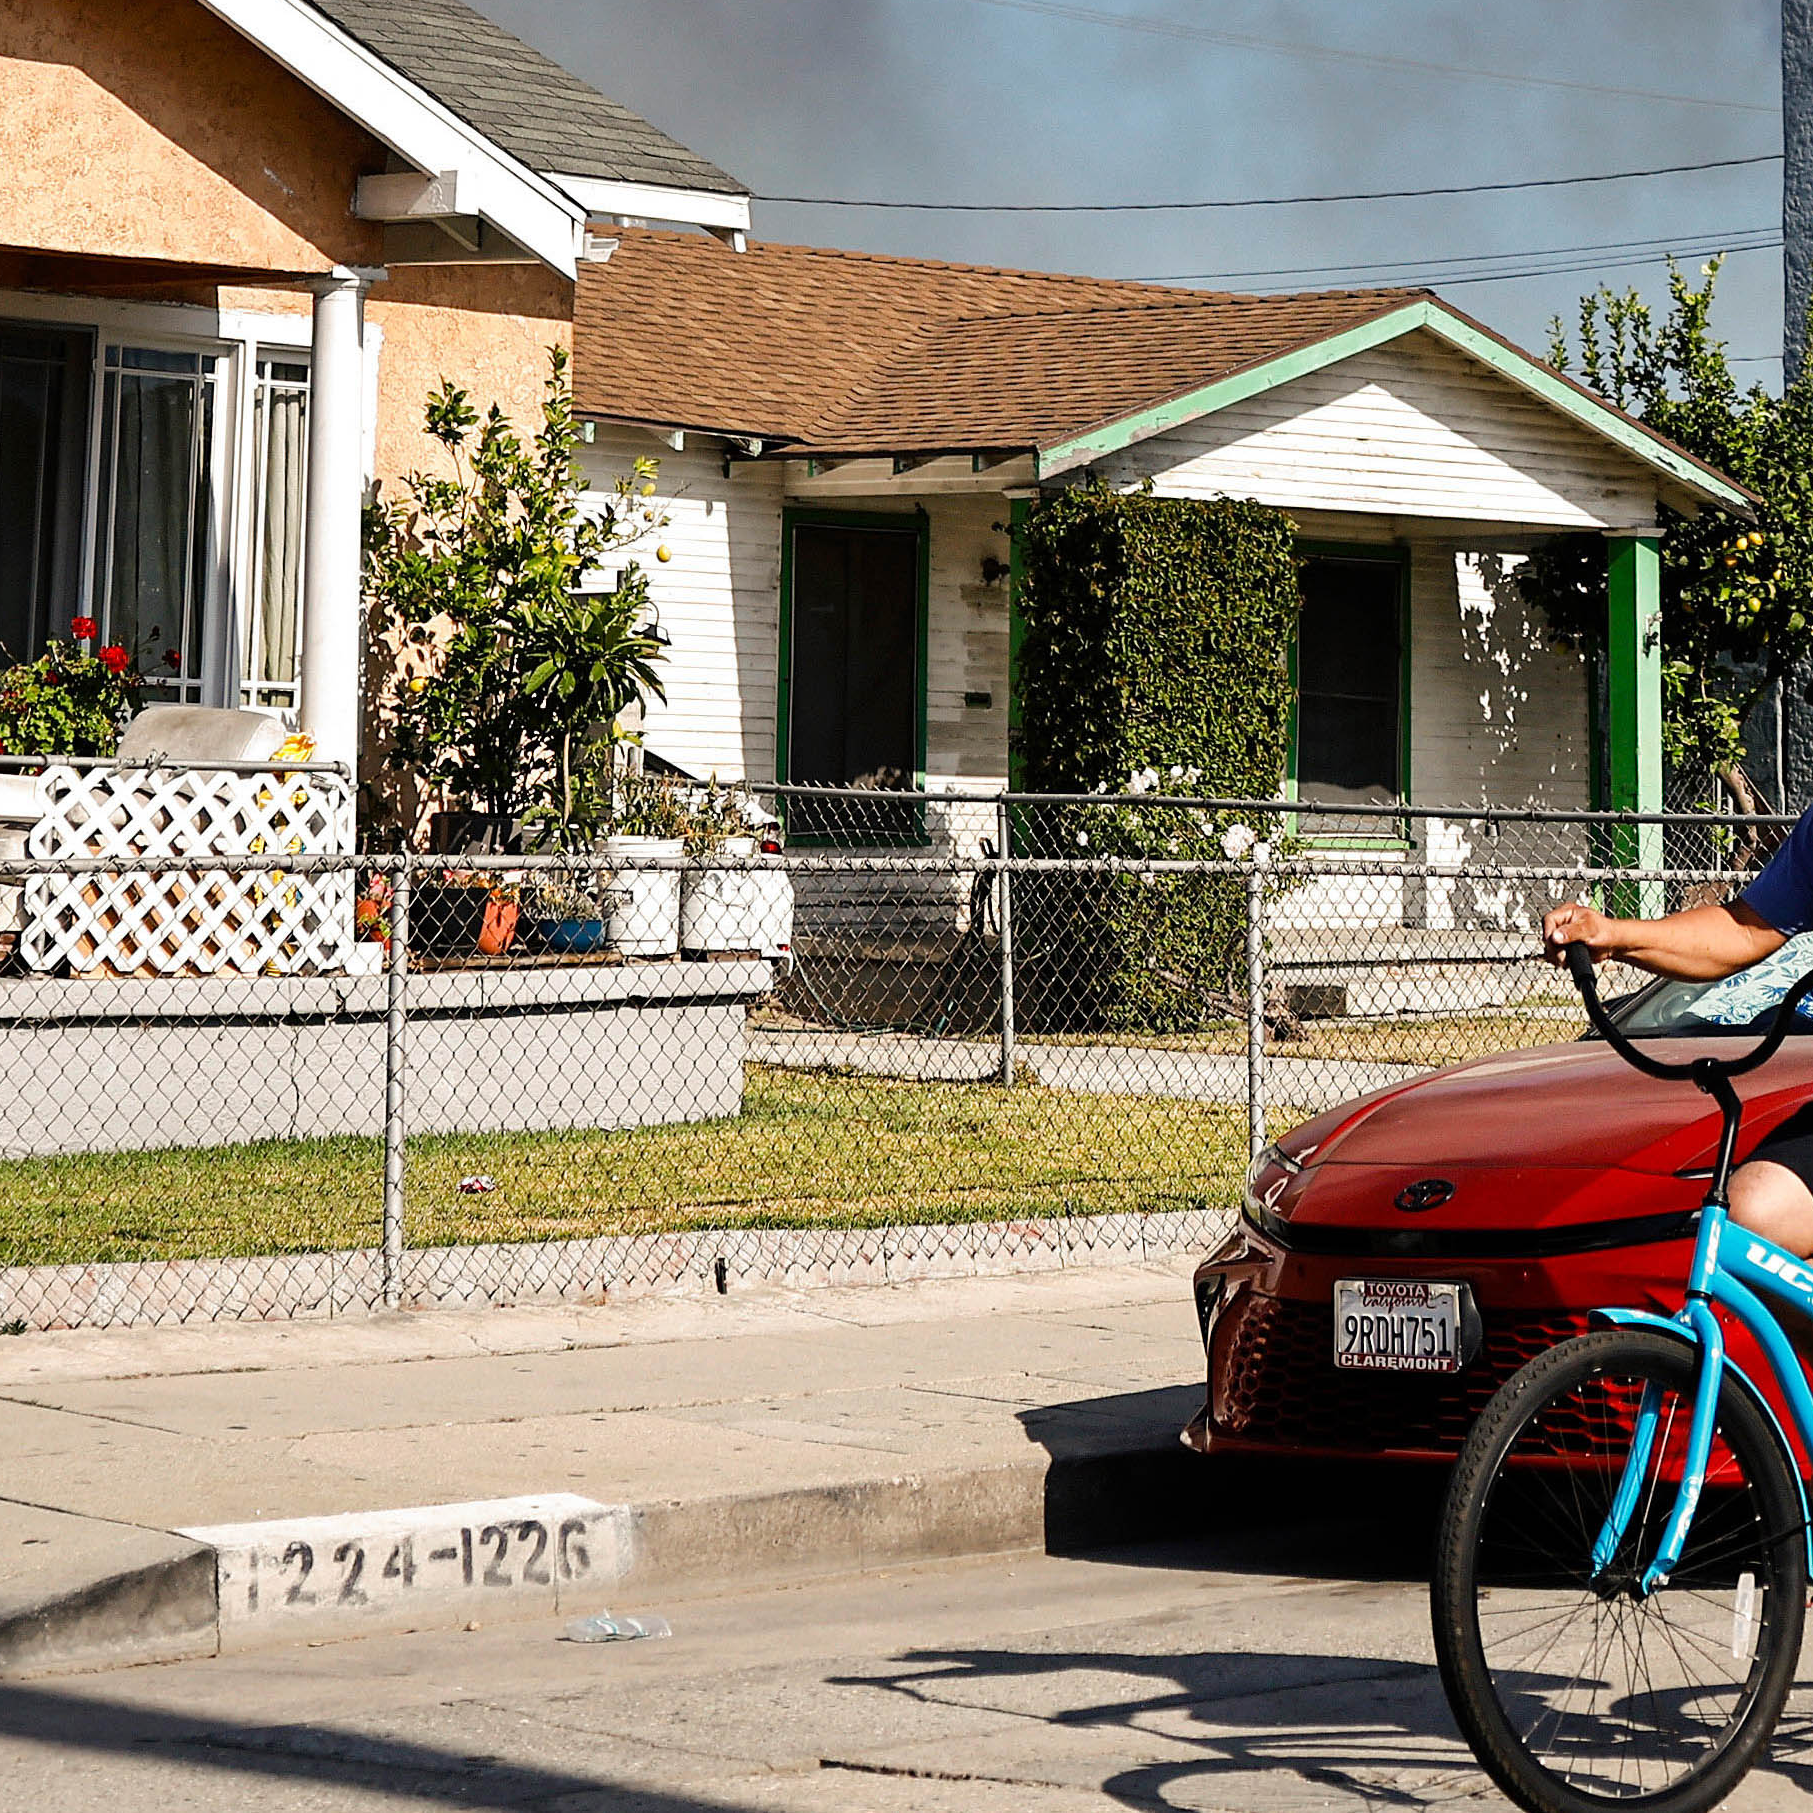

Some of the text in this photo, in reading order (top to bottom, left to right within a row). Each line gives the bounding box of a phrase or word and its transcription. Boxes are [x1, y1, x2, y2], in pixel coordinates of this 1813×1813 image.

[1367, 1283, 1426, 1297] TOYOTA
[1344, 1315, 1452, 1356] 9RDH751
[1340, 1354, 1451, 1371] CLAREMONT
